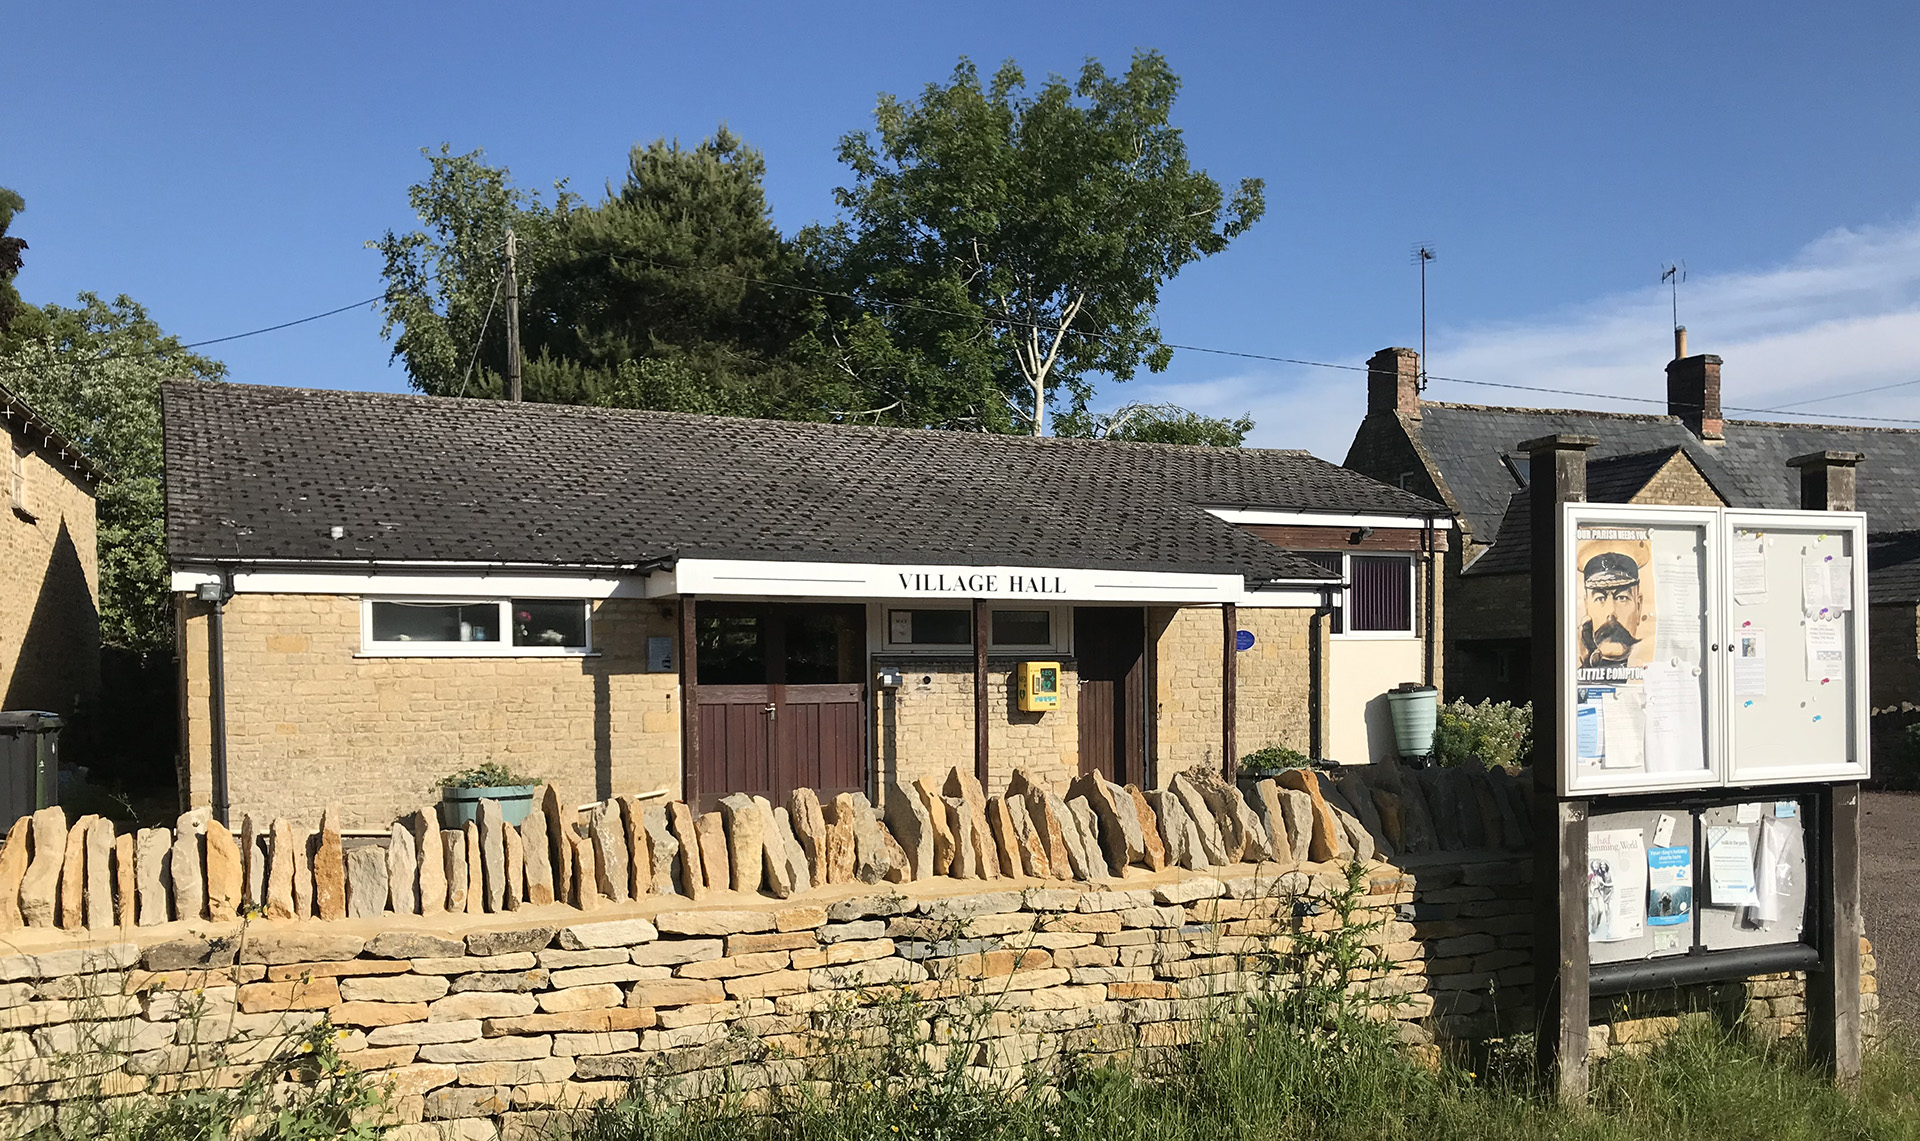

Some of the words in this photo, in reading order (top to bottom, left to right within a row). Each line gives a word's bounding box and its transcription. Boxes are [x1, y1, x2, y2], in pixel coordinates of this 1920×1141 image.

[1577, 529, 1592, 540] OUR
[1592, 529, 1617, 540] PARISH
[1617, 530, 1635, 540] NEEDS
[898, 573, 998, 592] VILLAGE
[1009, 575, 1066, 593] HALL
[1577, 667, 1606, 681] LITTLE
